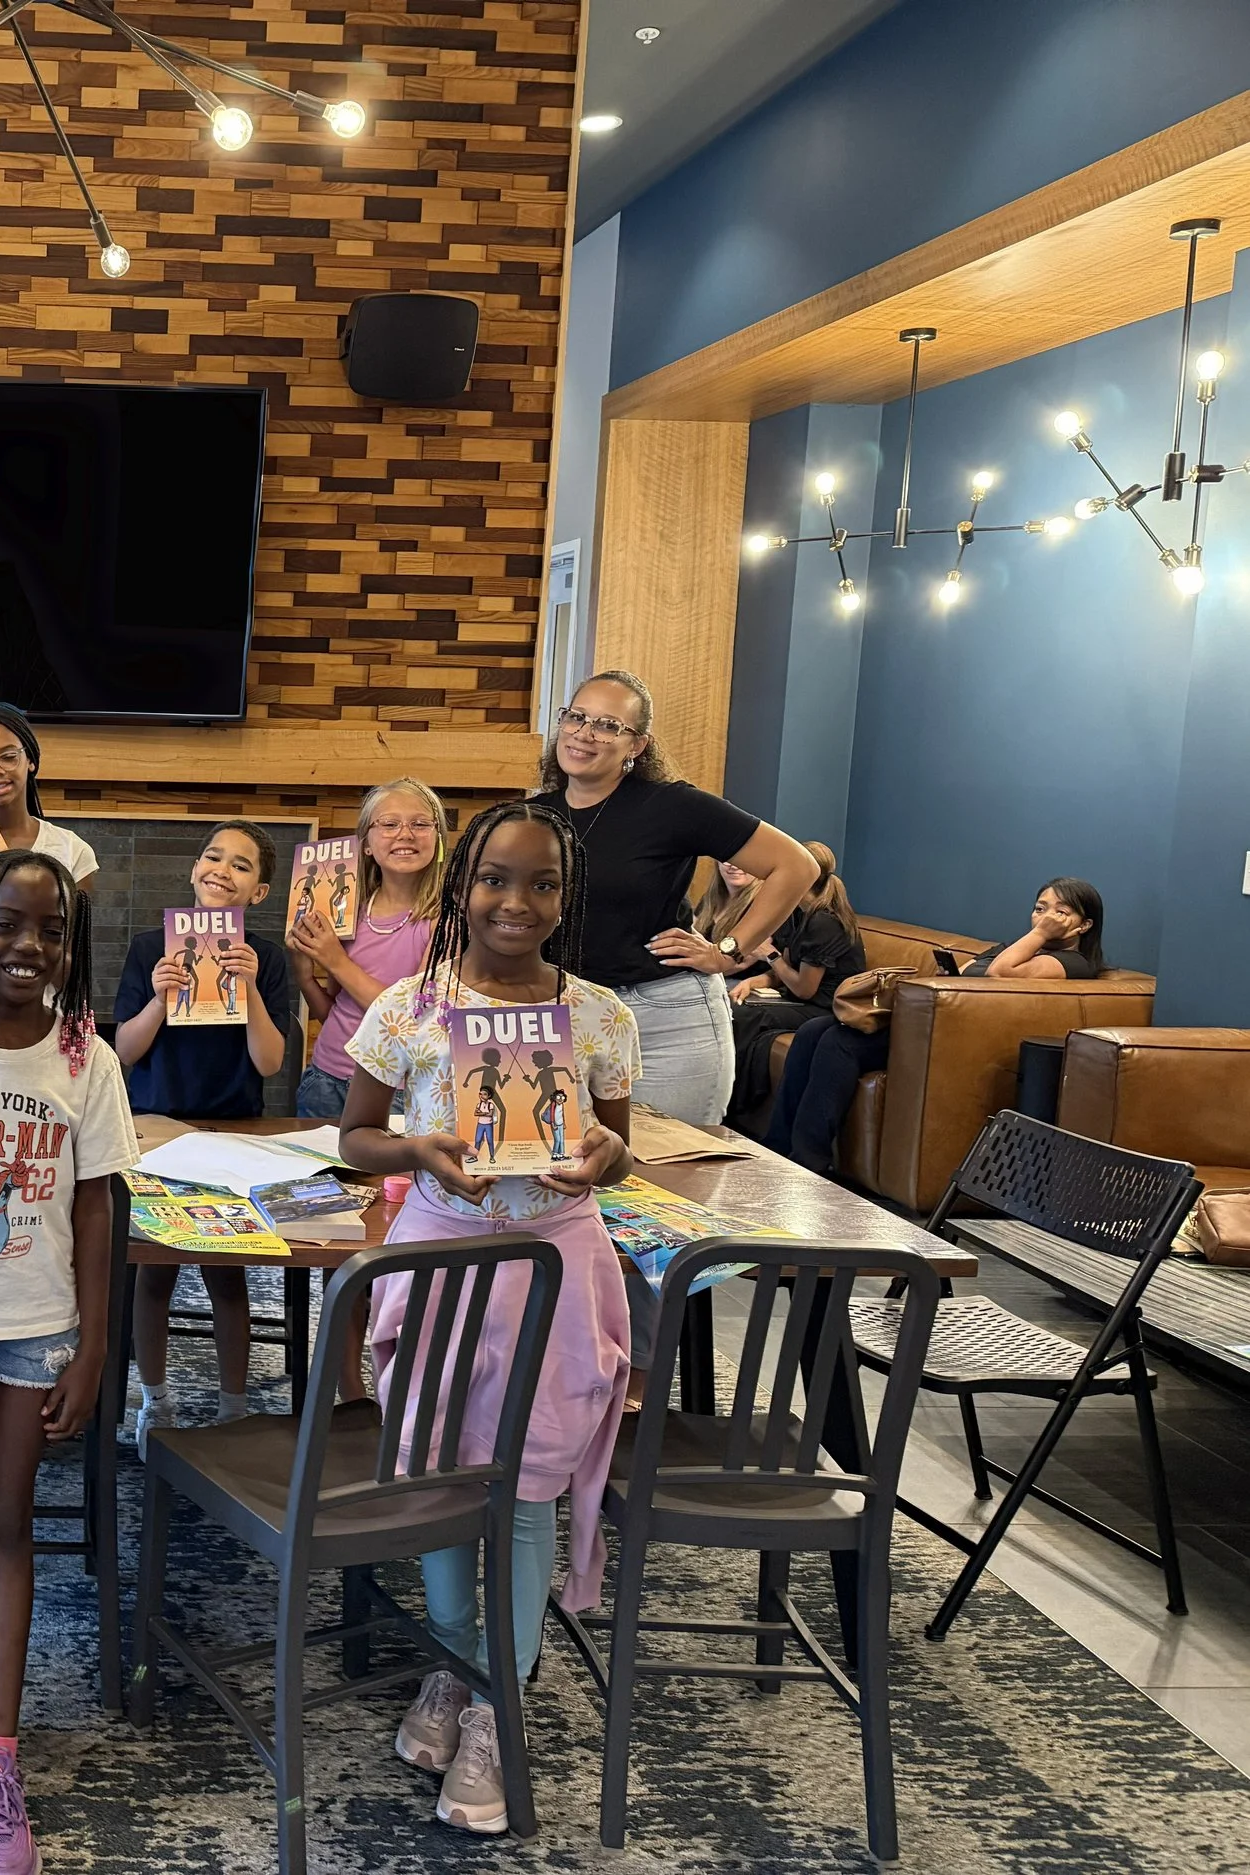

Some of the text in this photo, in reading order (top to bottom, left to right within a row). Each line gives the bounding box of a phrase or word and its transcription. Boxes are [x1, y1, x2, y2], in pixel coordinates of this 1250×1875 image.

[300, 839, 354, 865] DUEL
[174, 911, 238, 935] DUEL
[465, 1011, 562, 1046] DUEL
[0, 1091, 51, 1122] YORK
[11, 1214, 43, 1228] CRIME
[1, 1242, 31, 1256] Sense
